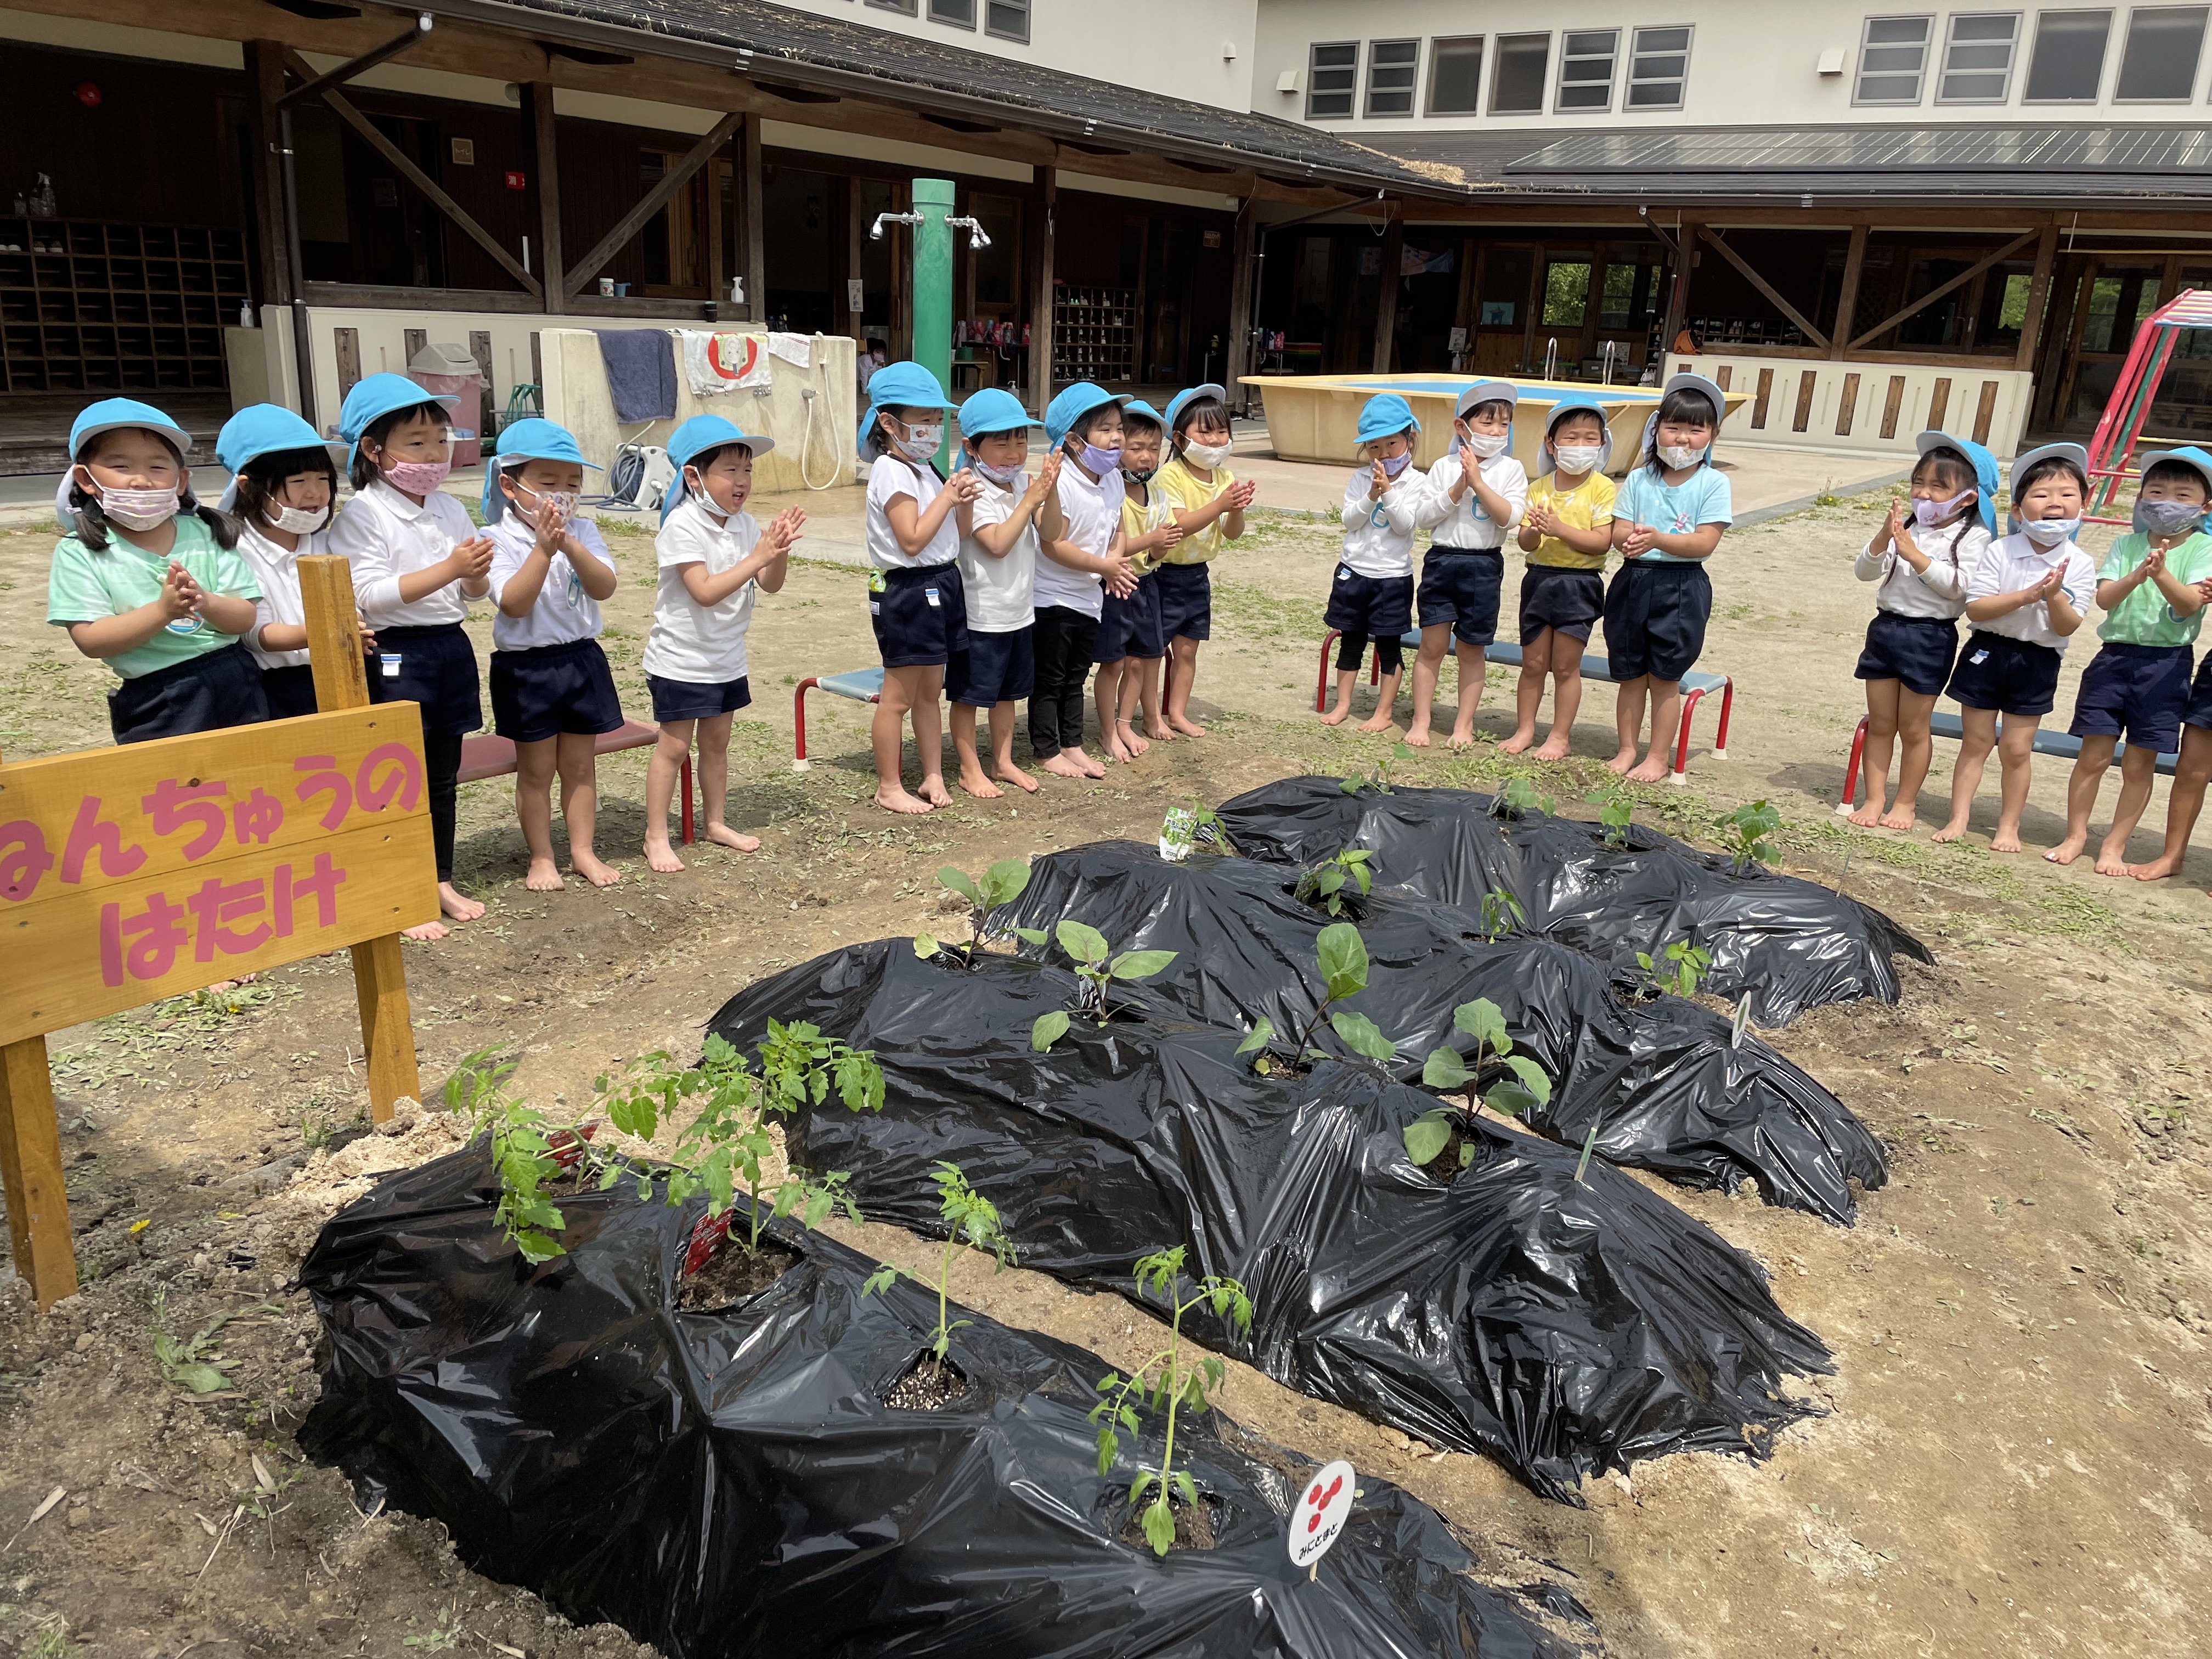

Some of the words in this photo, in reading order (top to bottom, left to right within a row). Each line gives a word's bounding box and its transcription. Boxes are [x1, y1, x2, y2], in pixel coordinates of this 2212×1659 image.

[100, 851, 346, 988] はたけ
[1299, 1522, 1338, 1560] みにとまと
